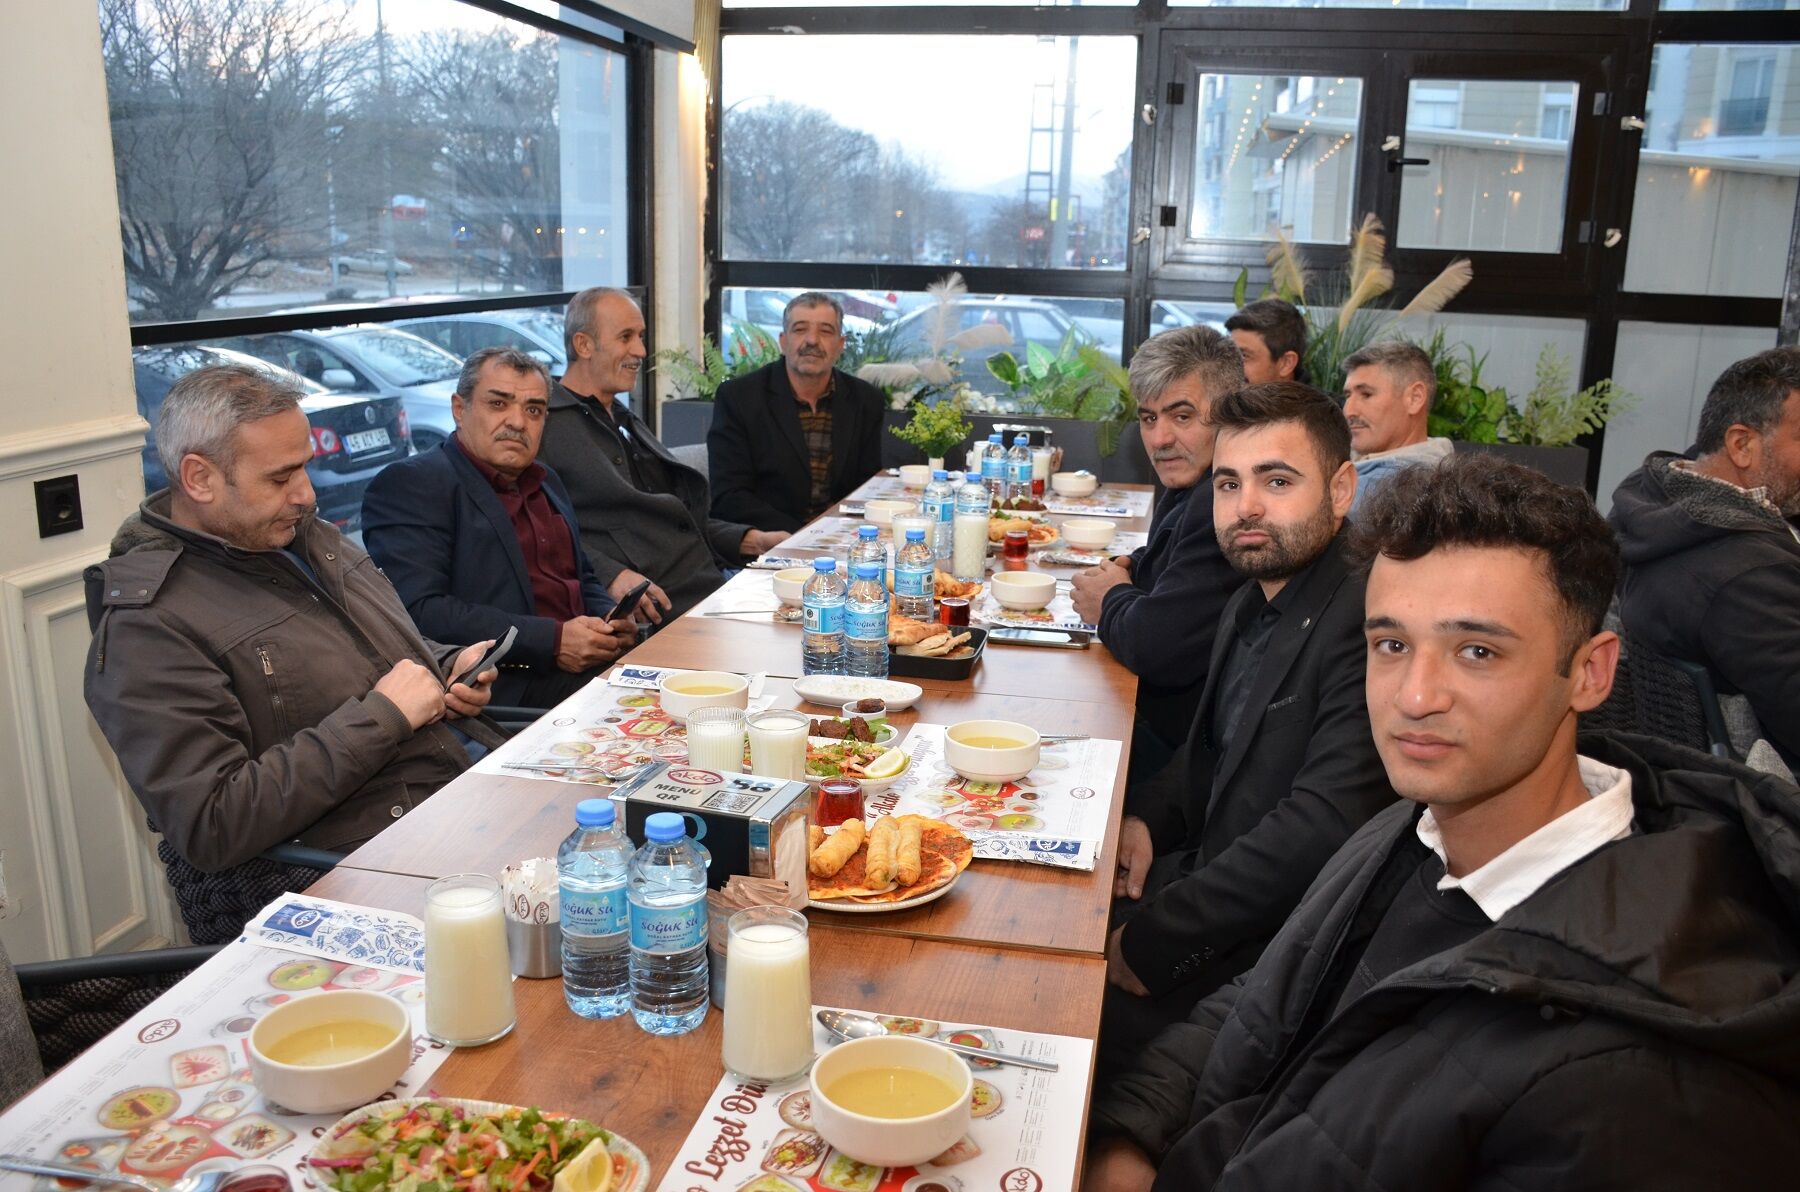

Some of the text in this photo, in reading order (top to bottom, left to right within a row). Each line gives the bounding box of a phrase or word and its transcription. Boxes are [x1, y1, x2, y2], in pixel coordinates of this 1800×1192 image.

[671, 771, 717, 783] akdo
[656, 793, 680, 801] QR
[685, 1116, 751, 1181] Lezzet
